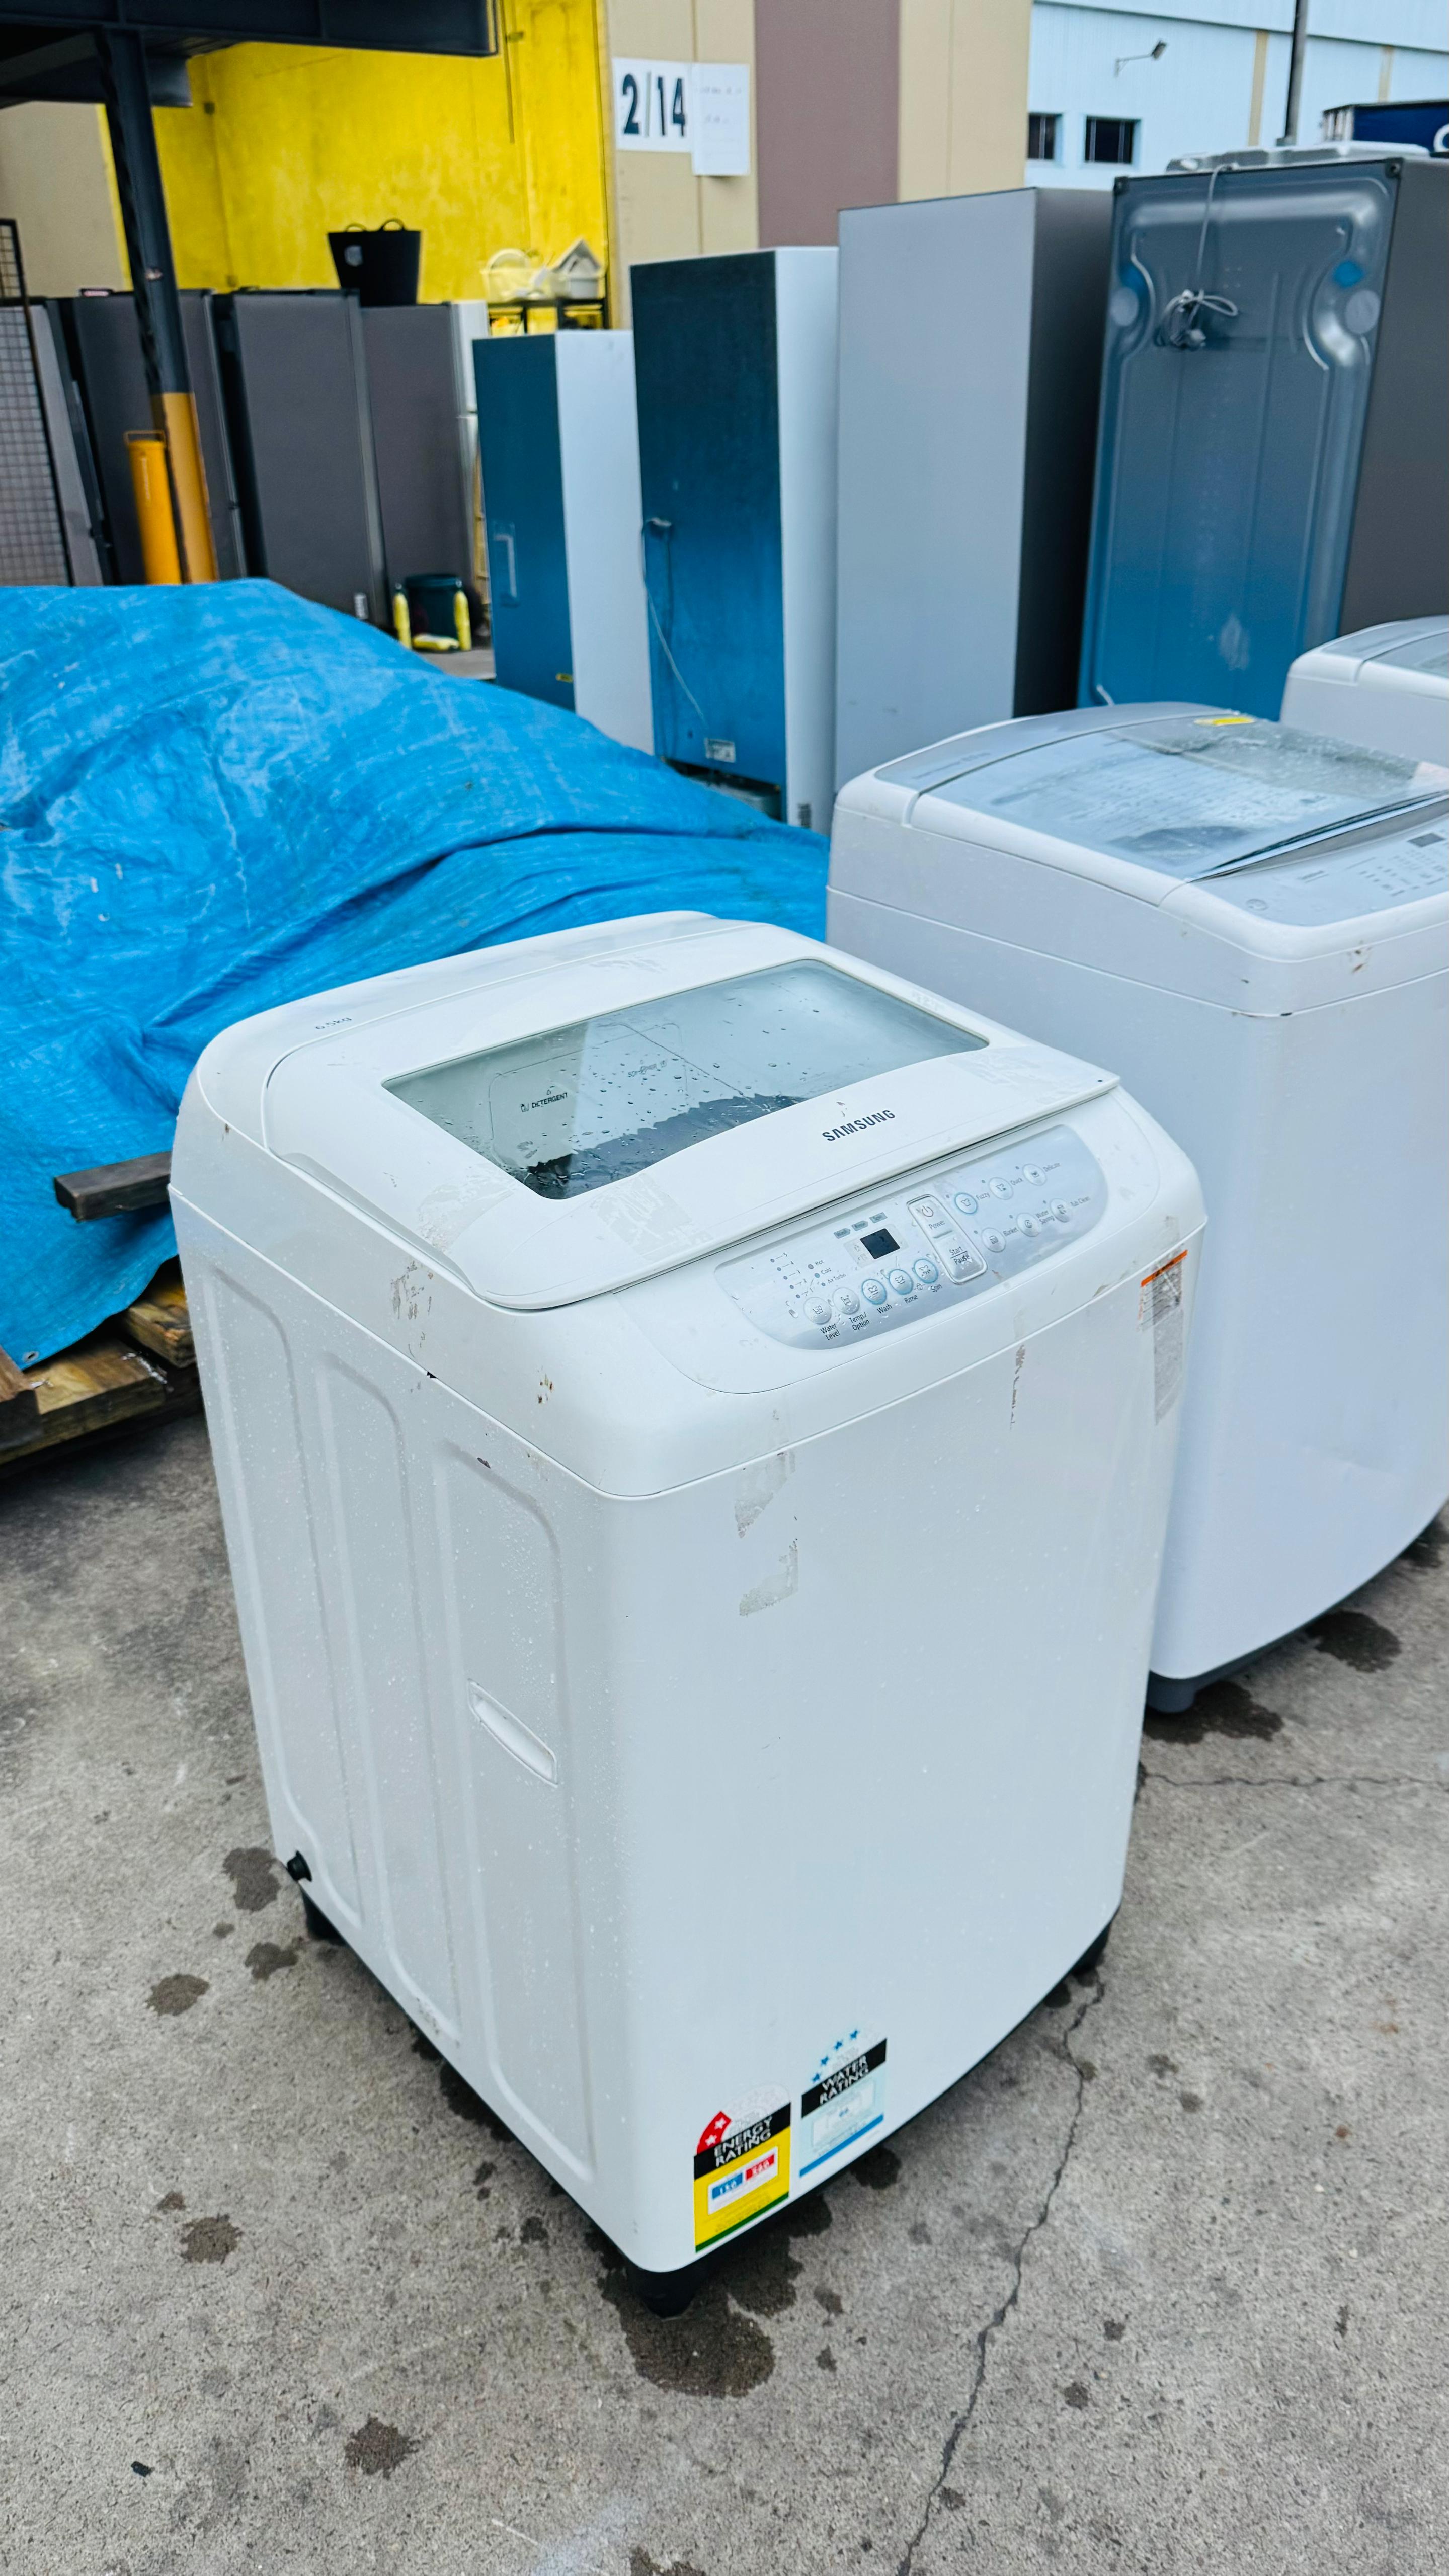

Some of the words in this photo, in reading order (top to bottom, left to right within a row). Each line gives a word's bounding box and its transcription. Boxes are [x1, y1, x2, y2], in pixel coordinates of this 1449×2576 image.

[532, 1092, 568, 1108] DETERGENT
[822, 1110, 895, 1141] SAMSUNG
[1010, 1177, 1023, 1186] Quick
[976, 1192, 990, 1200] Fuzzy
[929, 1220, 945, 1230] Power
[949, 1246, 963, 1256] Start
[953, 1254, 970, 1265] Pause
[905, 1294, 918, 1304] Rinse
[877, 1303, 893, 1314] Wash
[820, 1323, 837, 1334] Water
[852, 1318, 870, 1331] Option
[826, 1329, 840, 1341] Level
[822, 2055, 867, 2091] WATER
[820, 2065, 869, 2105] RATING
[714, 2116, 773, 2158] ENERGY
[715, 2128, 772, 2168] RATING
